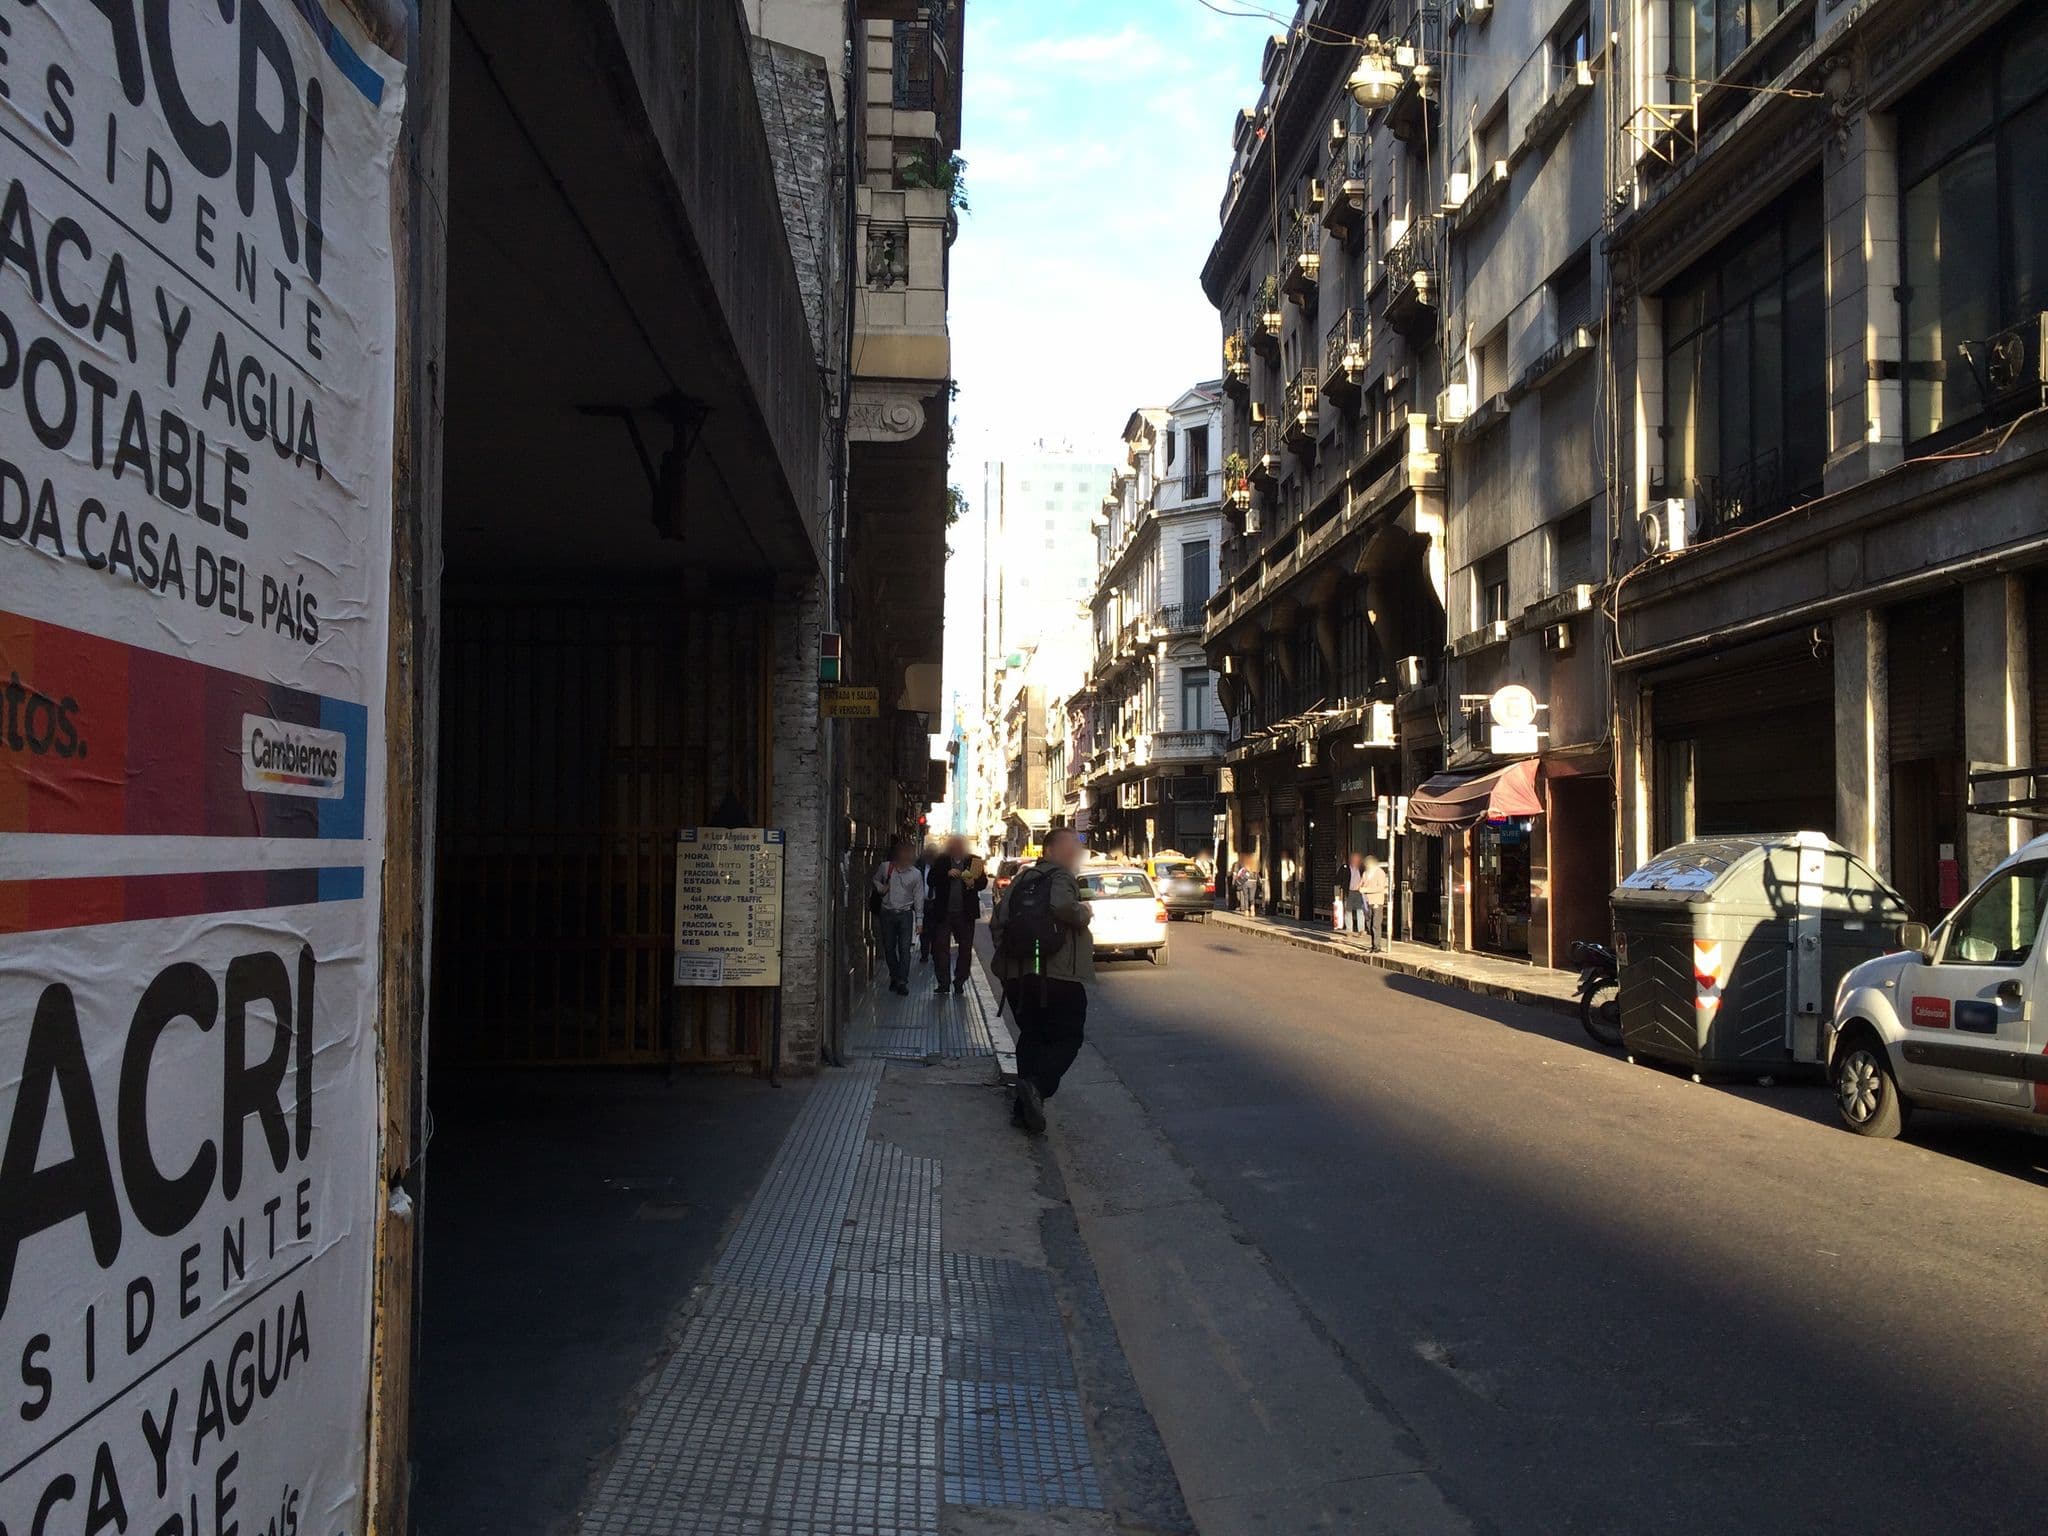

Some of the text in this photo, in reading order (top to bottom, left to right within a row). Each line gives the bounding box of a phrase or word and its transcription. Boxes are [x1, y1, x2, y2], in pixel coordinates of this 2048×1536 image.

[155, 286, 191, 388] Y
[202, 332, 322, 480] AGUA
[77, 498, 185, 600] CASA
[195, 546, 254, 625] DEL
[262, 575, 320, 645] PAÍS
[0, 671, 88, 759] tos.
[252, 728, 338, 777] Cambiemos
[681, 829, 695, 840] E
[767, 830, 780, 841] E
[142, 1388, 178, 1499] Y
[192, 1290, 310, 1466] AGUA
